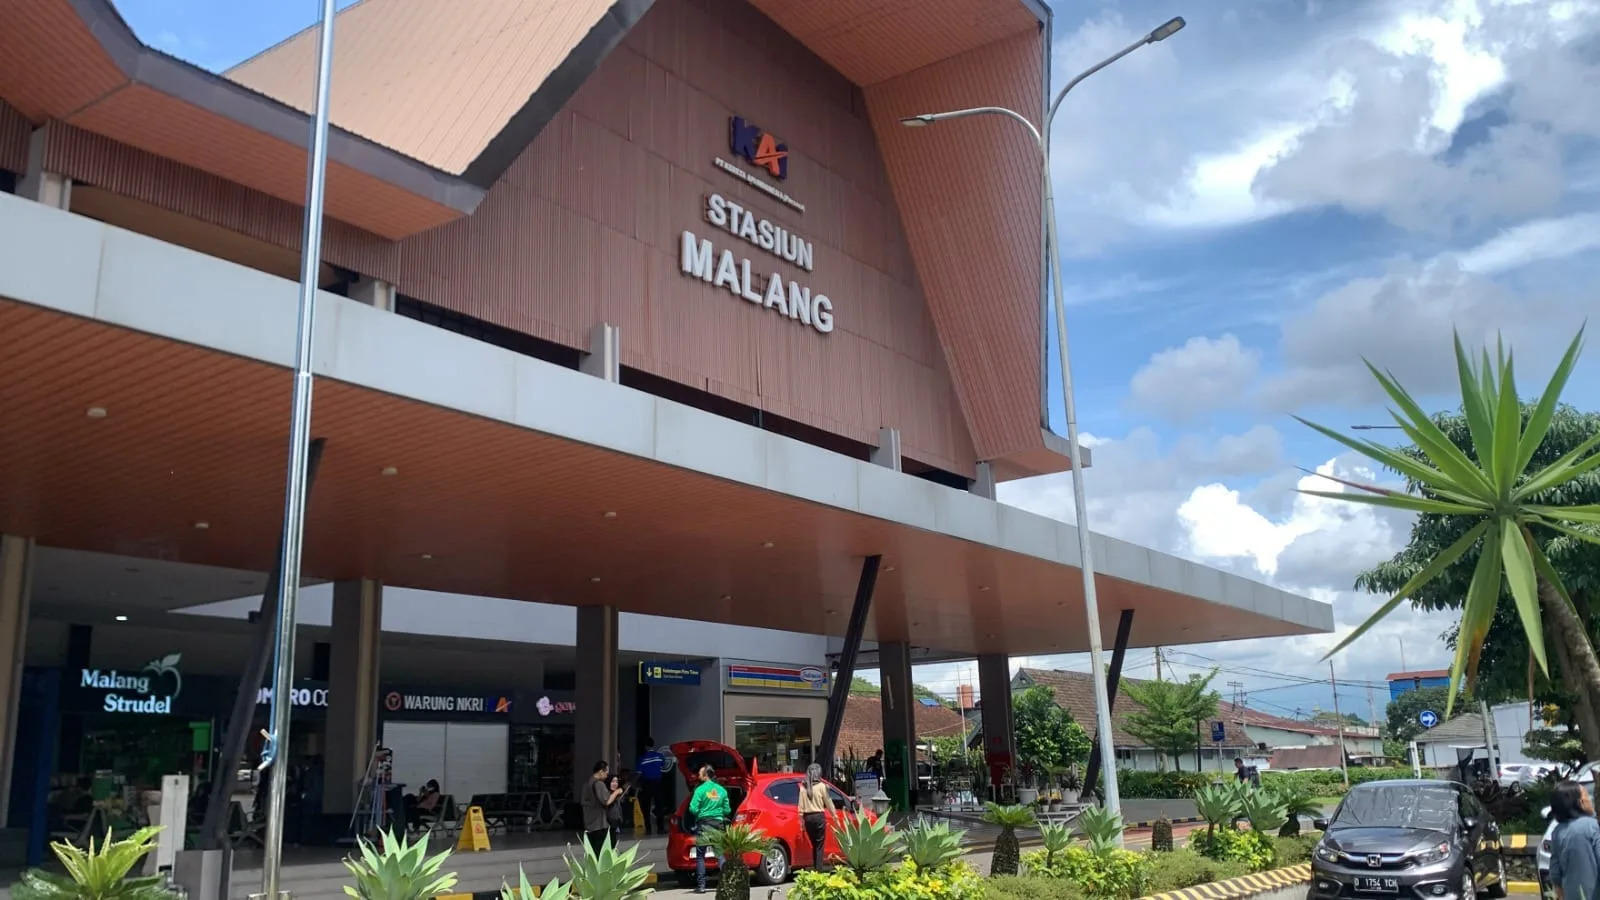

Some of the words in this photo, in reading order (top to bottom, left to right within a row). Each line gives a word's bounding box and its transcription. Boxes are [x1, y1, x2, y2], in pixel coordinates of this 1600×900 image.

[729, 115, 788, 180] KAI
[707, 193, 813, 271] STASIUN
[681, 230, 834, 333] MALANG
[81, 669, 150, 693] Malang
[103, 693, 171, 713] Strudel
[404, 695, 454, 711] WARUNG
[456, 697, 483, 712] NKRI
